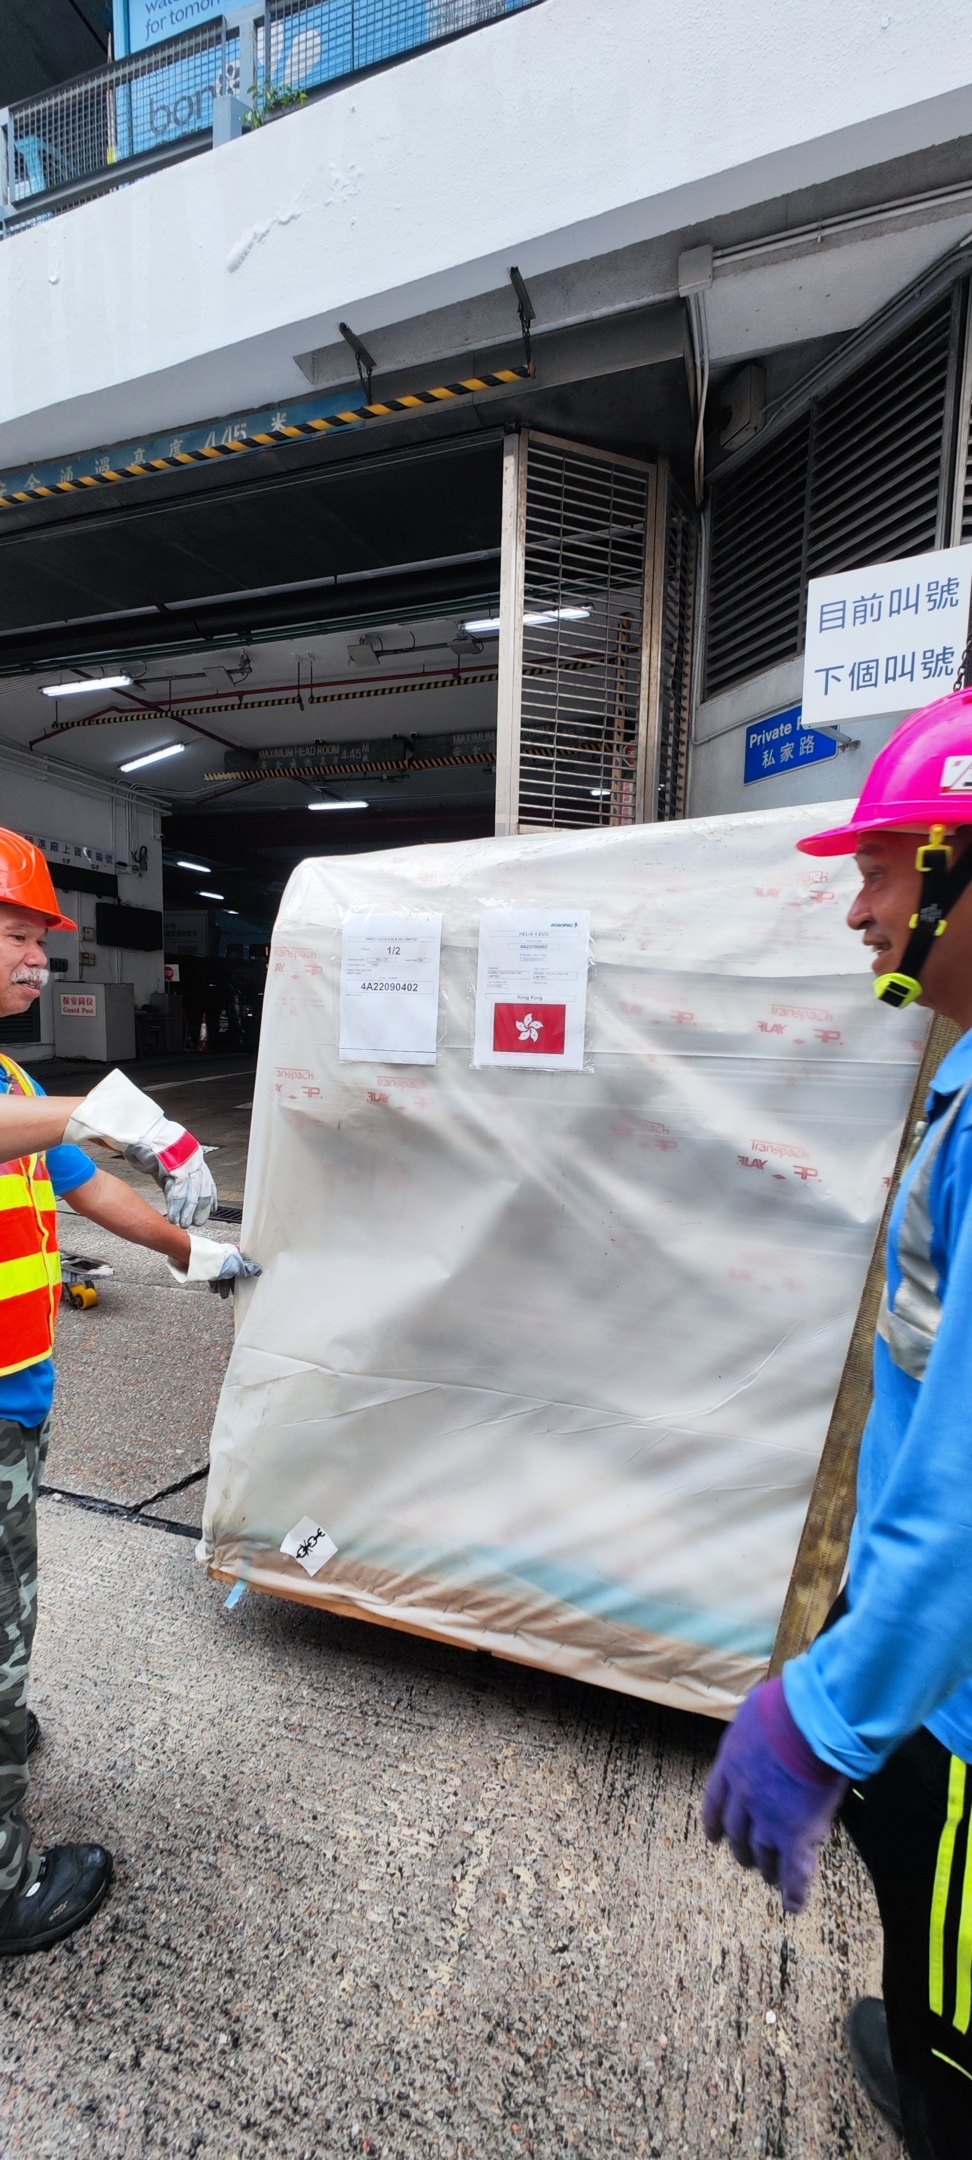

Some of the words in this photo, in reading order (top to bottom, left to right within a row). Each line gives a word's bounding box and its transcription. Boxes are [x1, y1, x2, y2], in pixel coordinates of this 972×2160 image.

[145, 15, 167, 41] for
[818, 577, 960, 633] 目前叫號
[814, 646, 955, 696] 下個叫號
[749, 723, 793, 749] Private
[294, 745, 316, 757] HEAD
[316, 743, 340, 756] ROOM
[761, 734, 815, 769] 私家路
[387, 946, 401, 956] 1/2
[360, 981, 419, 992] 4A22090402
[62, 1006, 80, 1014] Guard
